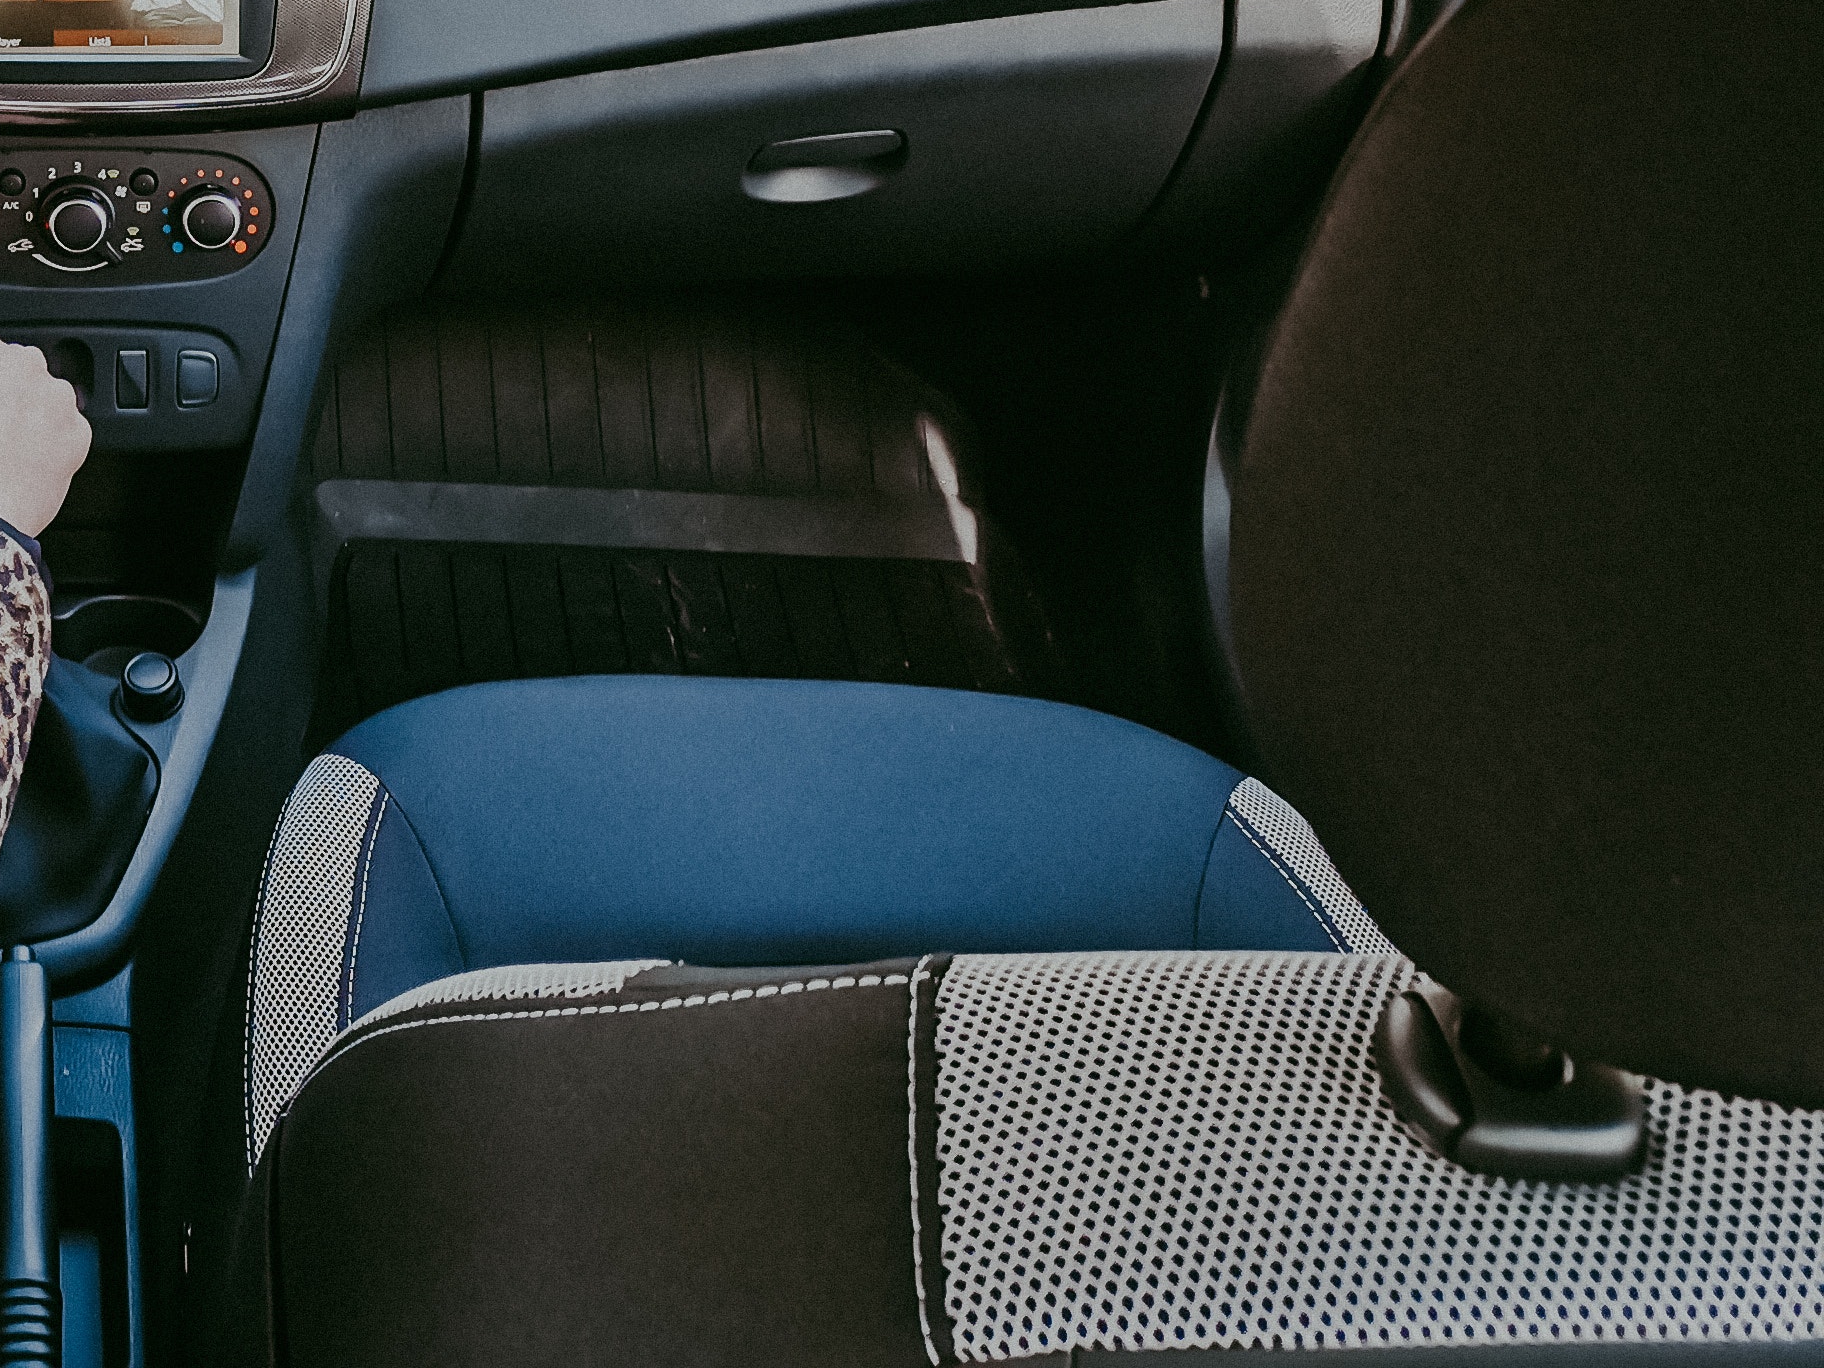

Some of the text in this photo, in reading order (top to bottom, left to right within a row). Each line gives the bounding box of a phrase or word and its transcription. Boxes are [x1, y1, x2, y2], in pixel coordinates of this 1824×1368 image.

[47, 167, 56, 179] 2
[73, 162, 82, 173] 3
[97, 169, 107, 180] 4
[32, 188, 39, 198] 1
[2, 201, 20, 210] A/C
[25, 211, 34, 222] 0
